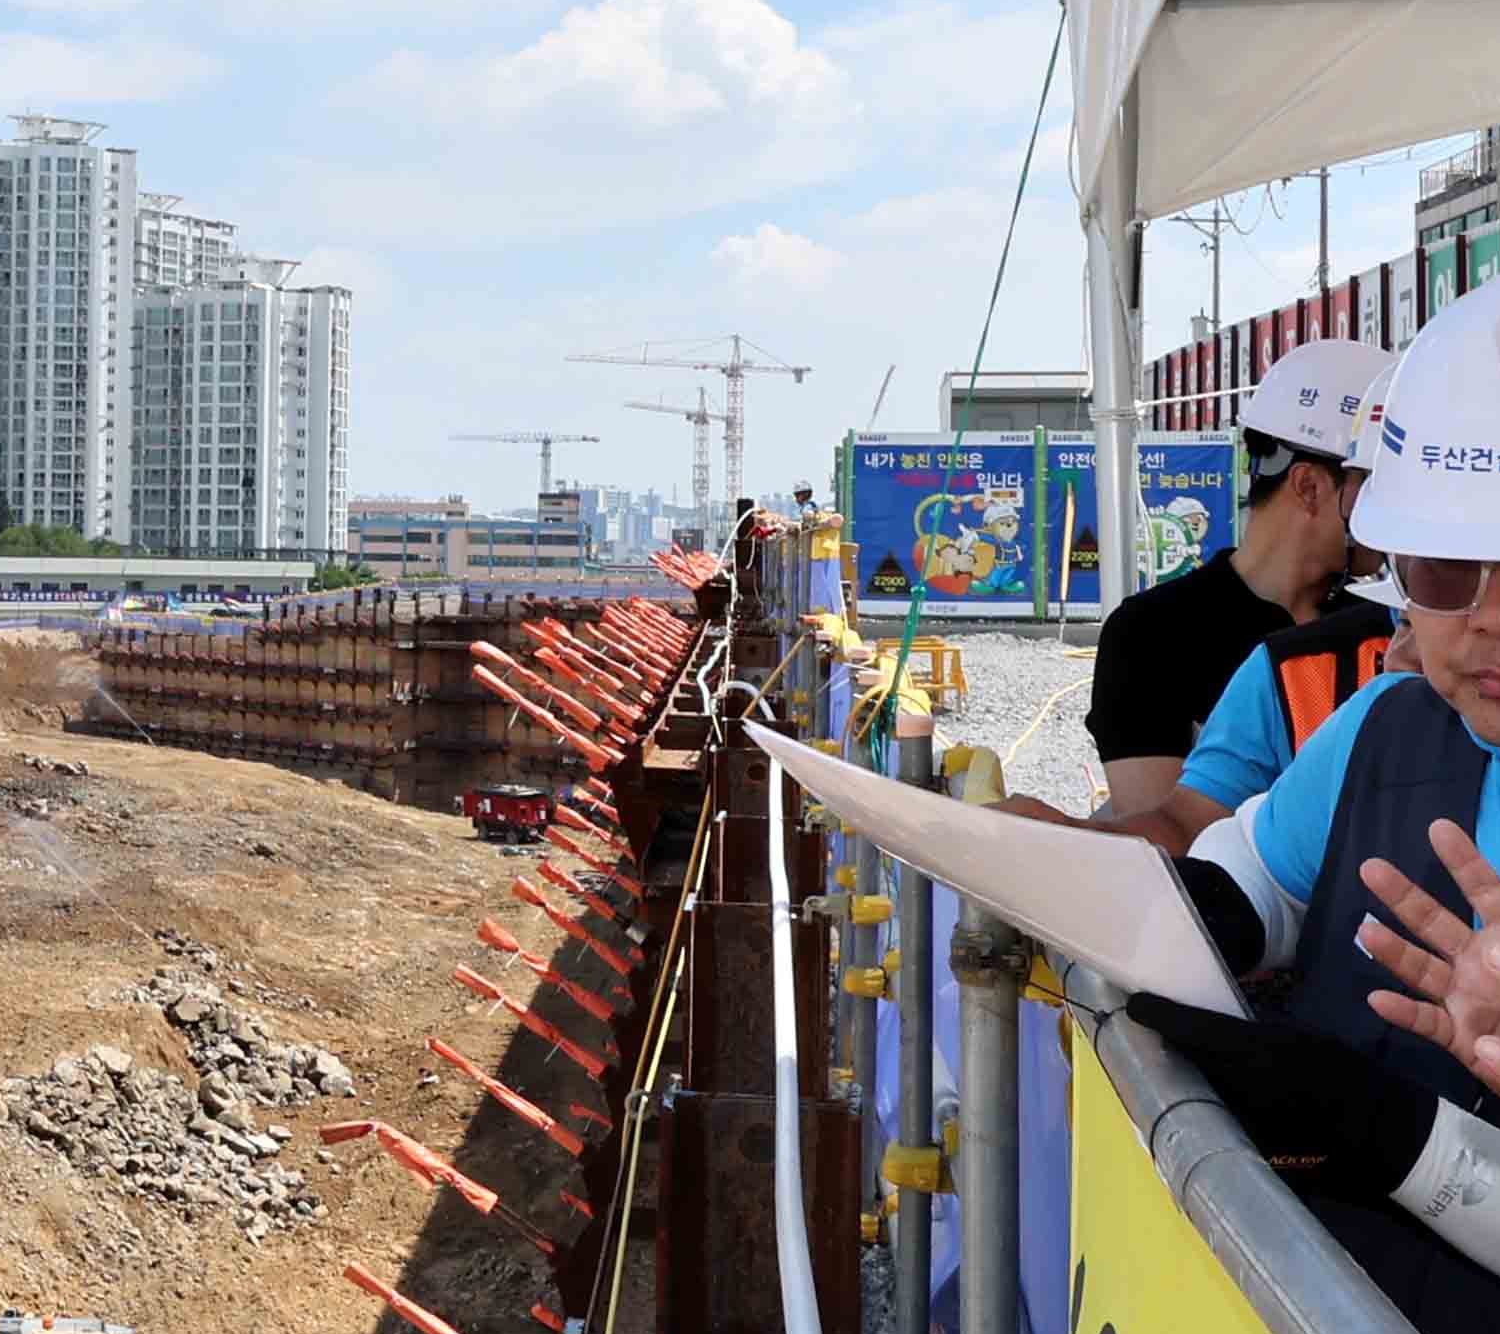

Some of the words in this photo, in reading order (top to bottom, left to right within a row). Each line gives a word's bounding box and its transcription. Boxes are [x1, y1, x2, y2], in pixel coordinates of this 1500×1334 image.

[864, 452, 895, 469] 내가
[1058, 452, 1097, 469] 안전
[1071, 551, 1098, 562] 2290
[873, 576, 906, 587] 22900
[1425, 1182, 1464, 1217] NEPA
